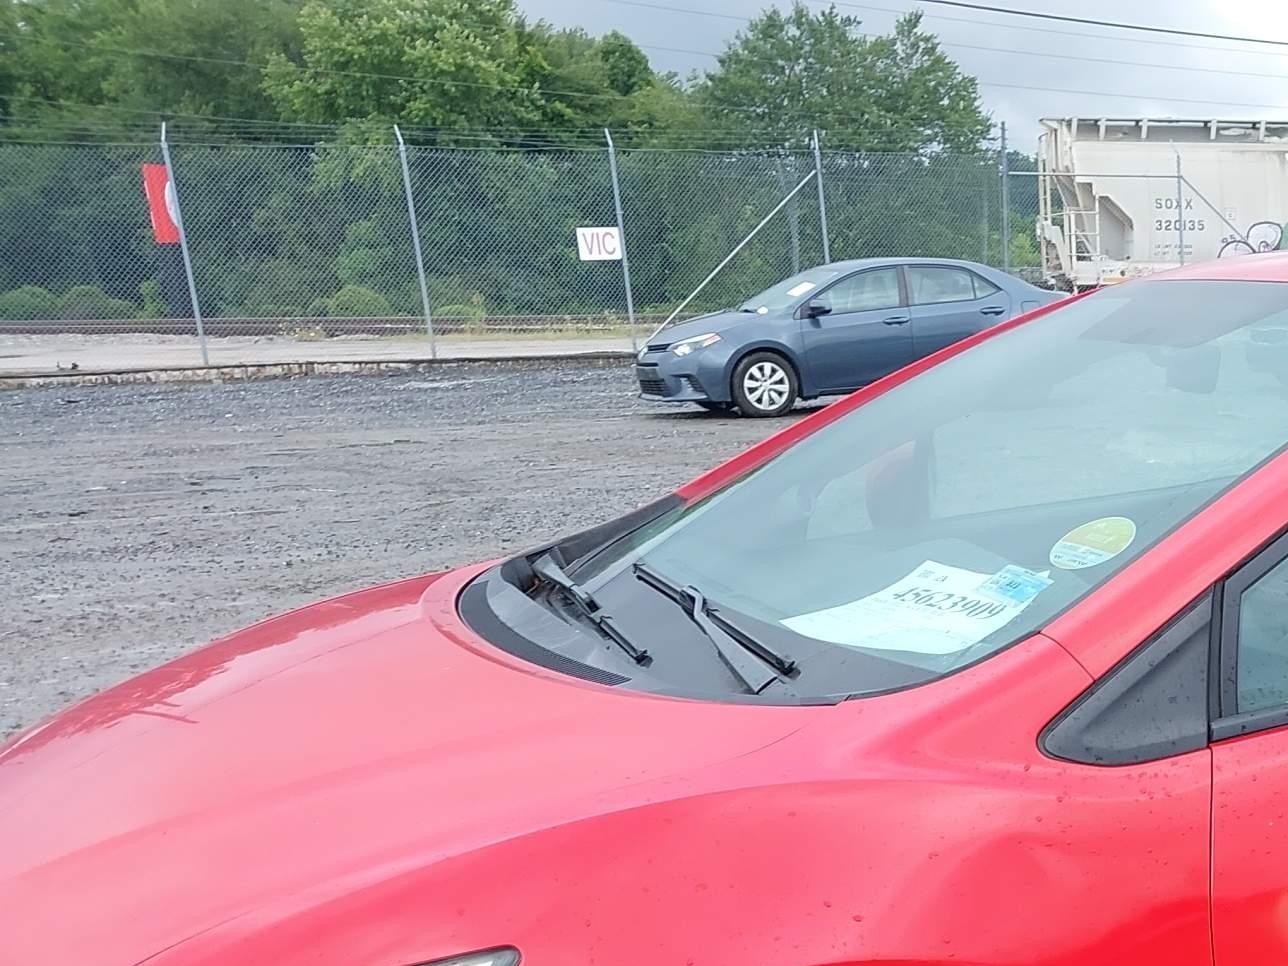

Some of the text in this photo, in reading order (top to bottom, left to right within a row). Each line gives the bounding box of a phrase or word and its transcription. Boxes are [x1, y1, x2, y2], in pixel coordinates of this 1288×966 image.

[1155, 198, 1193, 210] SOXX
[1155, 219, 1205, 231] 320135
[582, 231, 617, 256] VIC
[892, 587, 1008, 620] 45623909
